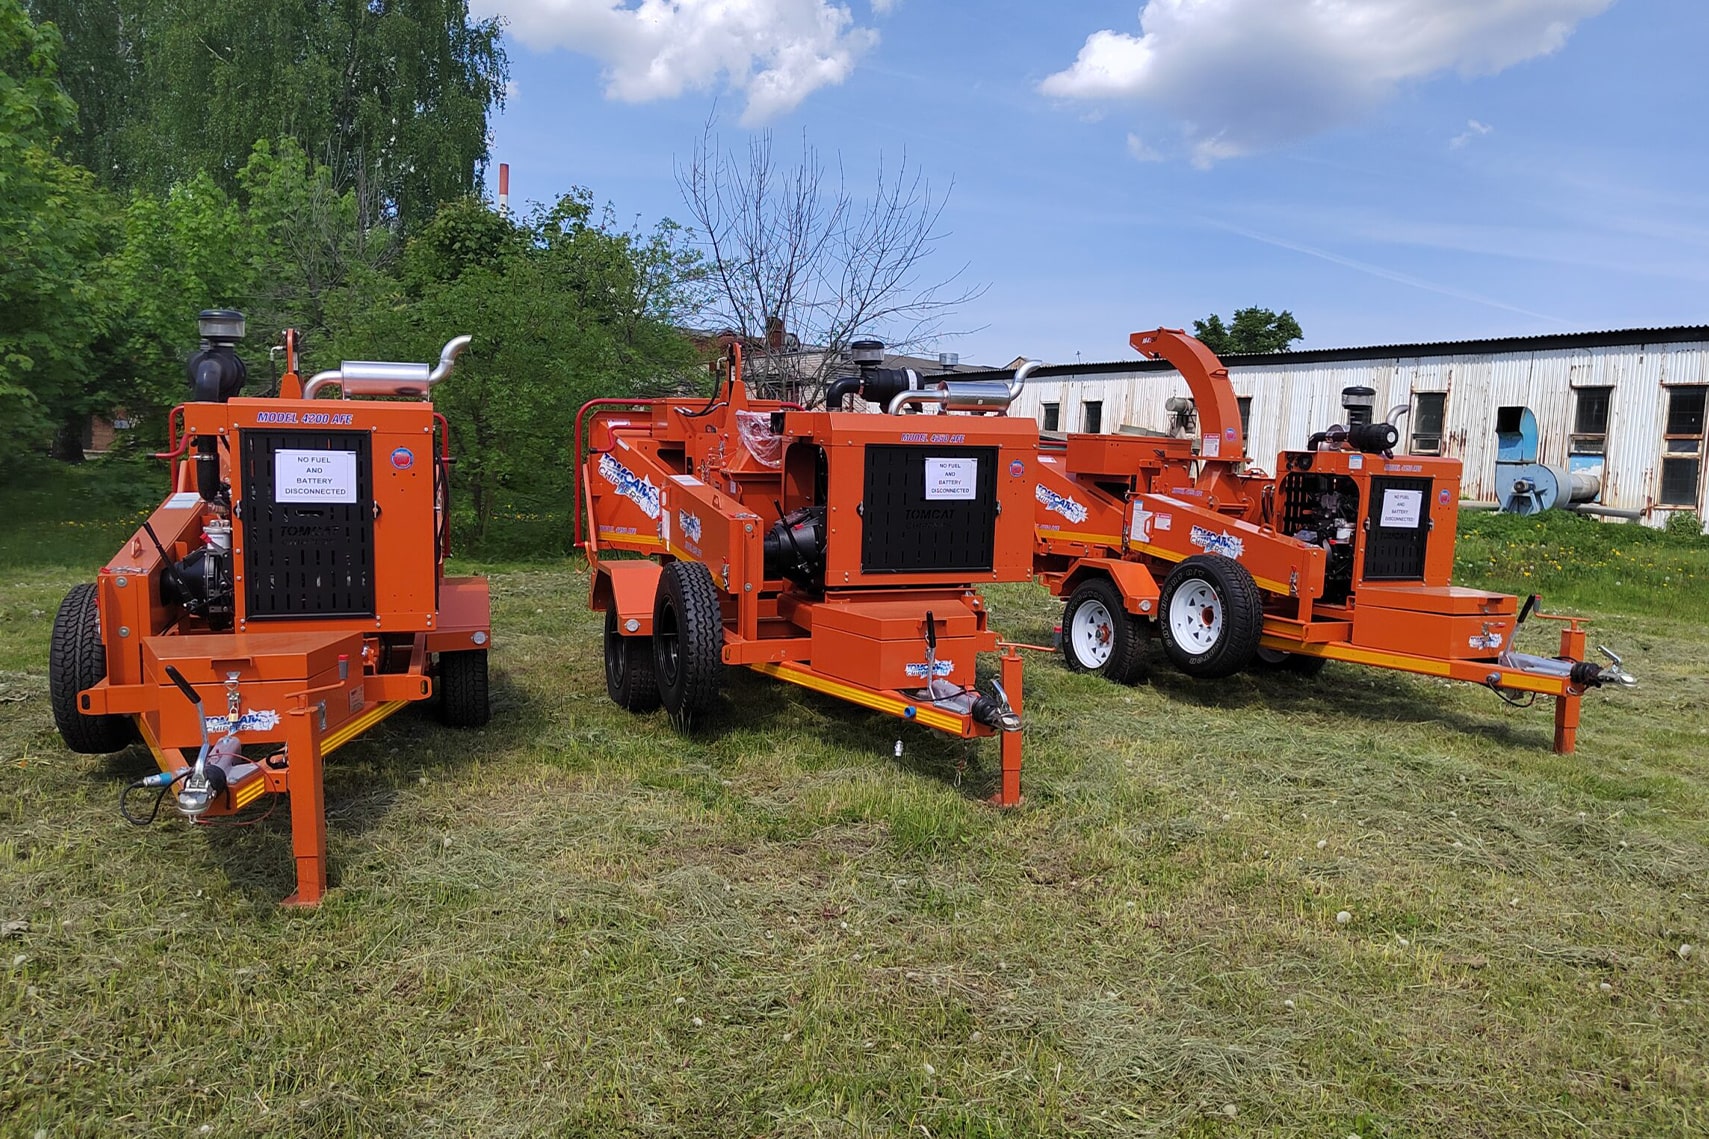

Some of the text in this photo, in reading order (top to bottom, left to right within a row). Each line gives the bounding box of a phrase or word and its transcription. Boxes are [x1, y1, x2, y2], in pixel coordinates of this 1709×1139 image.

[257, 412, 353, 424] MODEL 4200 AFE
[901, 433, 928, 442] MODEL
[905, 508, 955, 520] TOMCAT
